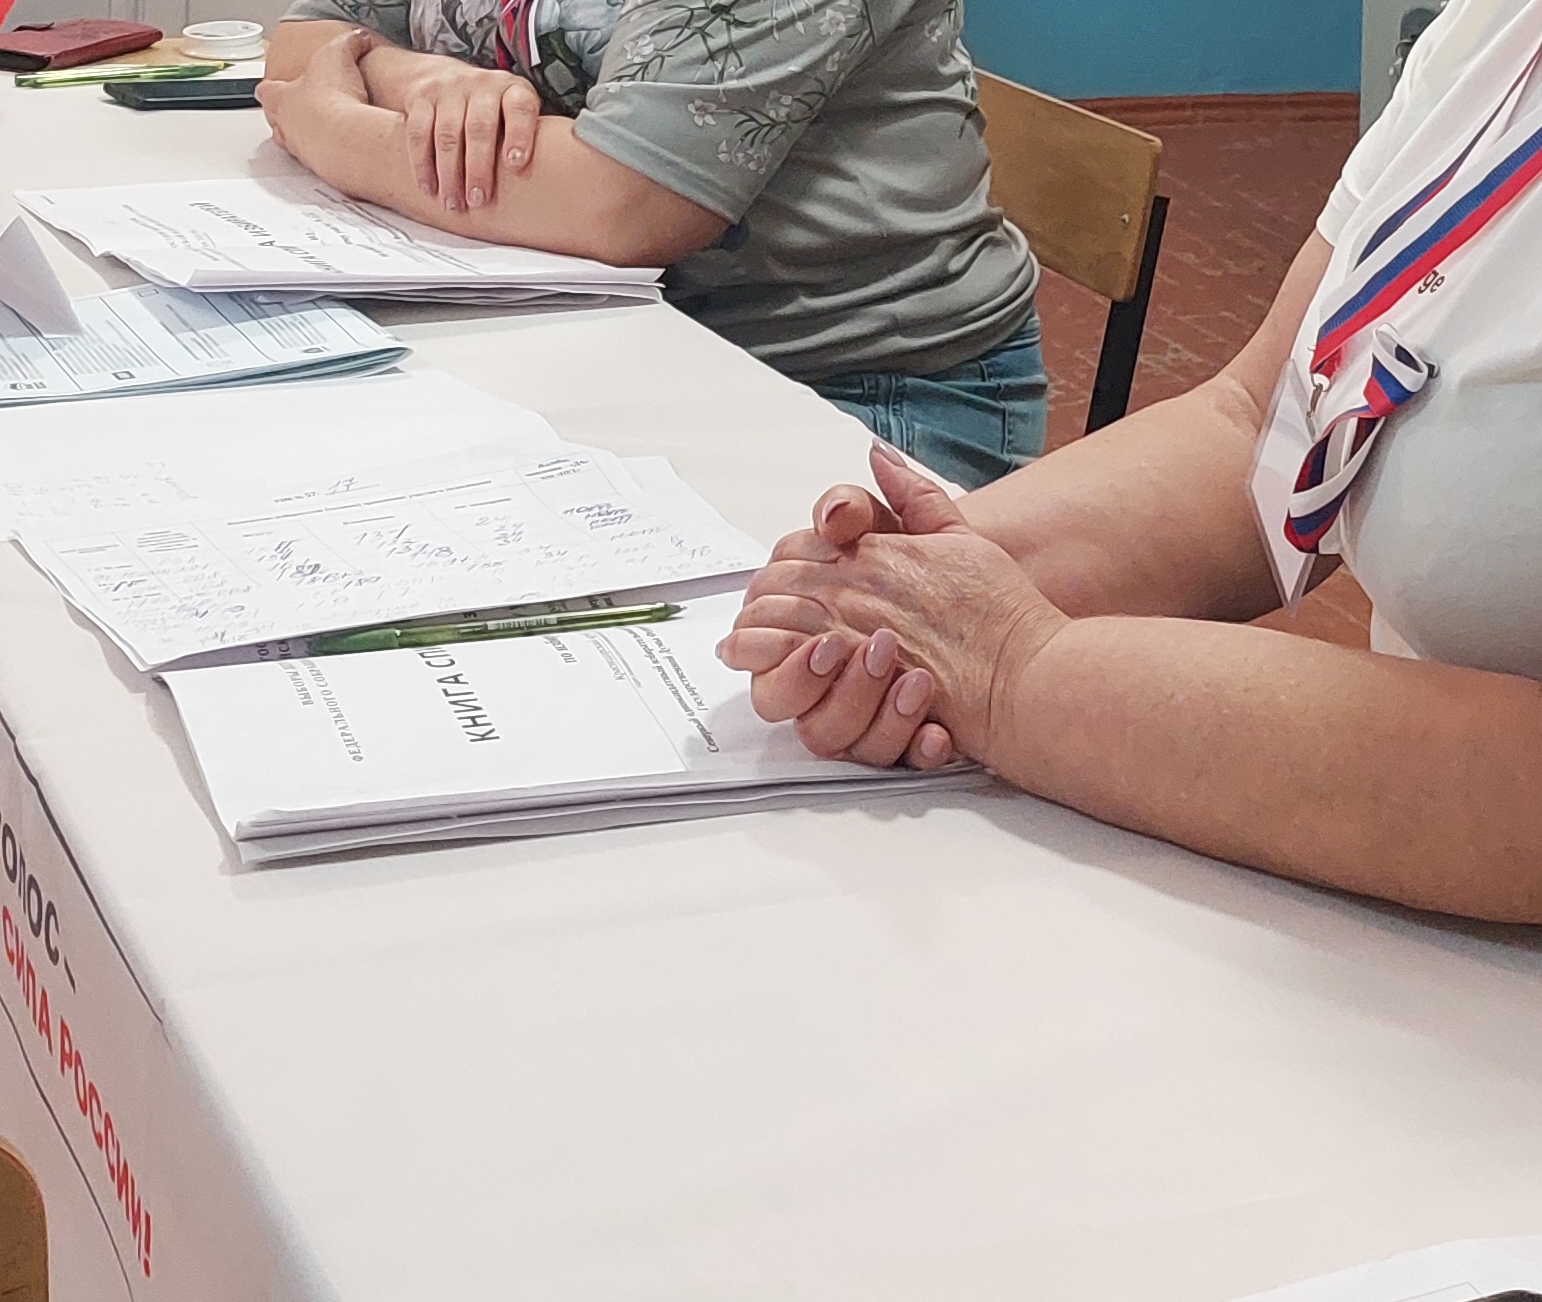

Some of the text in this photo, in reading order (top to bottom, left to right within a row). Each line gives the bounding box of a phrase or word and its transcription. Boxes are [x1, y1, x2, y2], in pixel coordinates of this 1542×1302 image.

[287, 667, 314, 707] ВЫБОРЫ
[322, 689, 364, 763] ФЕДЕРАЛЬНОГО
[418, 647, 501, 743] КНИГА СП
[2, 904, 152, 1279] СИЛА РОССИИ!
